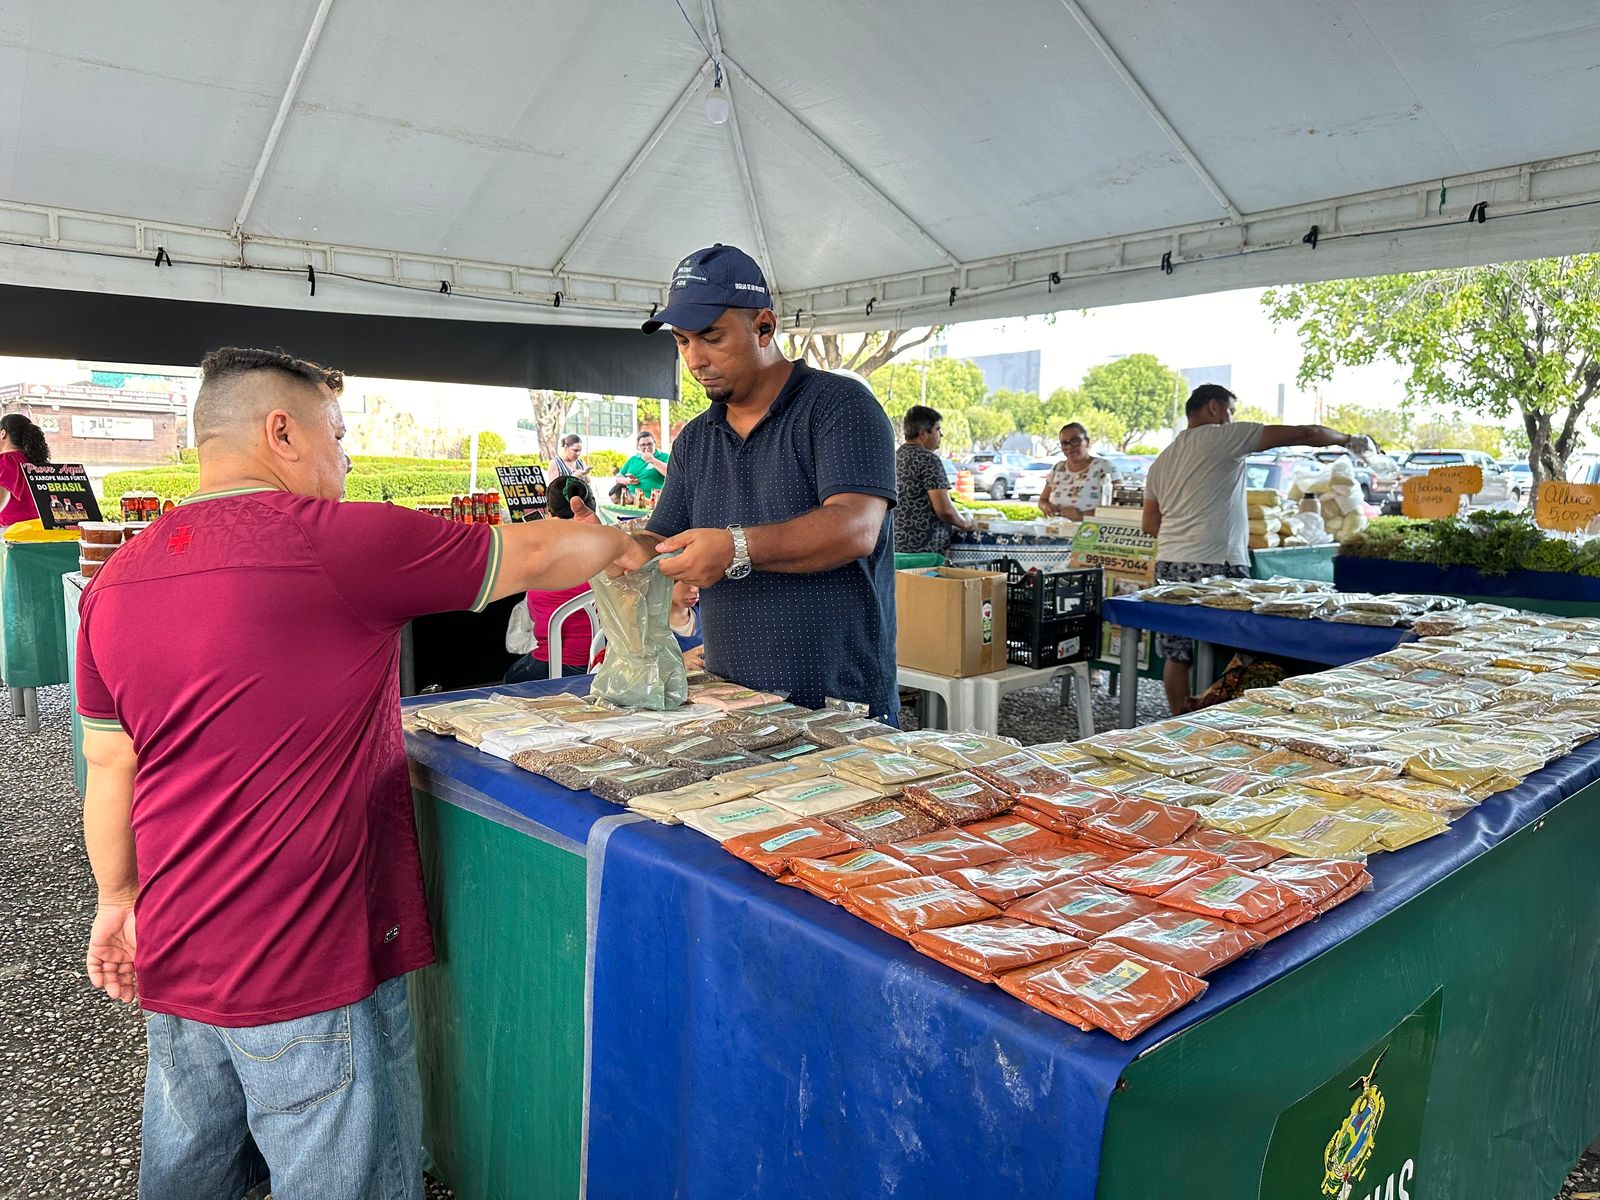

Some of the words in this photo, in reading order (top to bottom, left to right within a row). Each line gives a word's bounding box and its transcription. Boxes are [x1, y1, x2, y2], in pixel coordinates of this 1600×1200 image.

[59, 464, 84, 475] Aqui
[497, 467, 531, 477] ELEITO
[533, 467, 540, 475] O
[500, 475, 544, 486] MELHOR
[47, 483, 86, 492] BRASIL
[503, 485, 534, 498] MEL
[507, 497, 520, 506] DO
[1547, 506, 1580, 523] 5,00
[1098, 535, 1110, 543] DE
[1112, 537, 1154, 548] AUTAZES
[1086, 554, 1148, 571] 99395-7044
